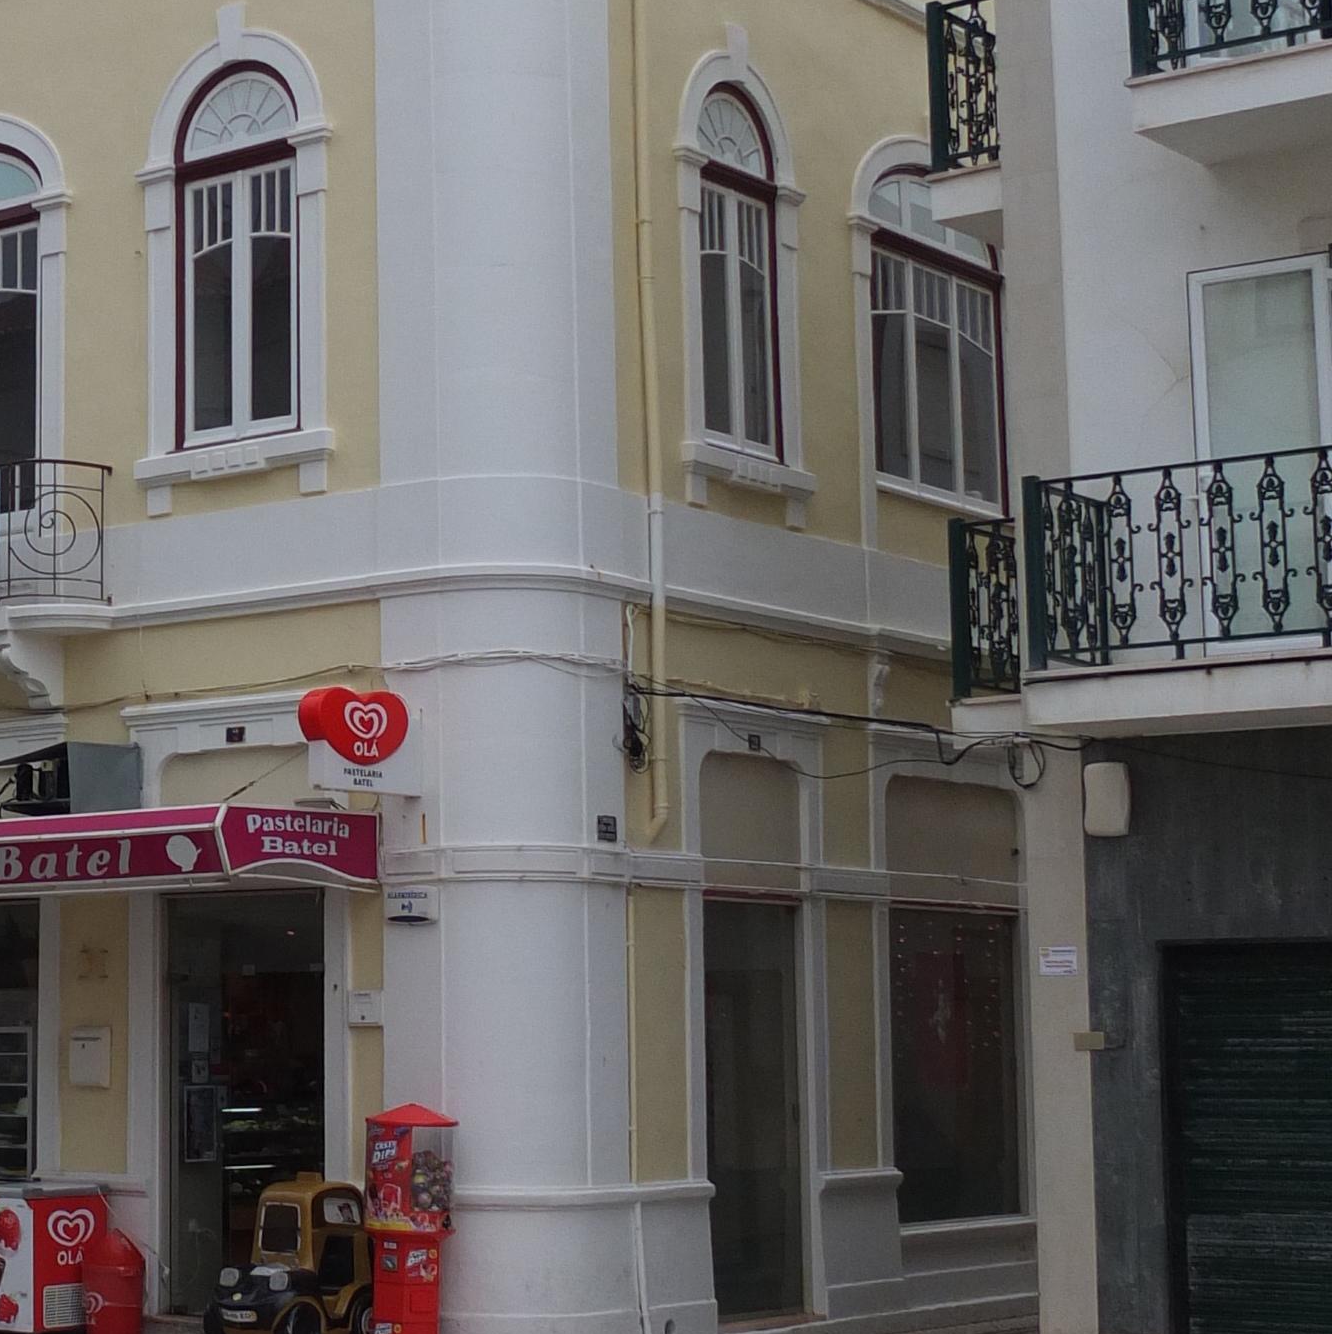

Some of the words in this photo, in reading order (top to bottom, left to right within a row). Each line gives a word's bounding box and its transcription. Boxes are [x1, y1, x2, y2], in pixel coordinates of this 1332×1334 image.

[353, 739, 379, 757] OLÁ
[343, 767, 383, 778] PASTELARIA
[353, 778, 374, 787] BATEL
[246, 813, 350, 839] Pastelaria
[261, 836, 338, 856] Batel
